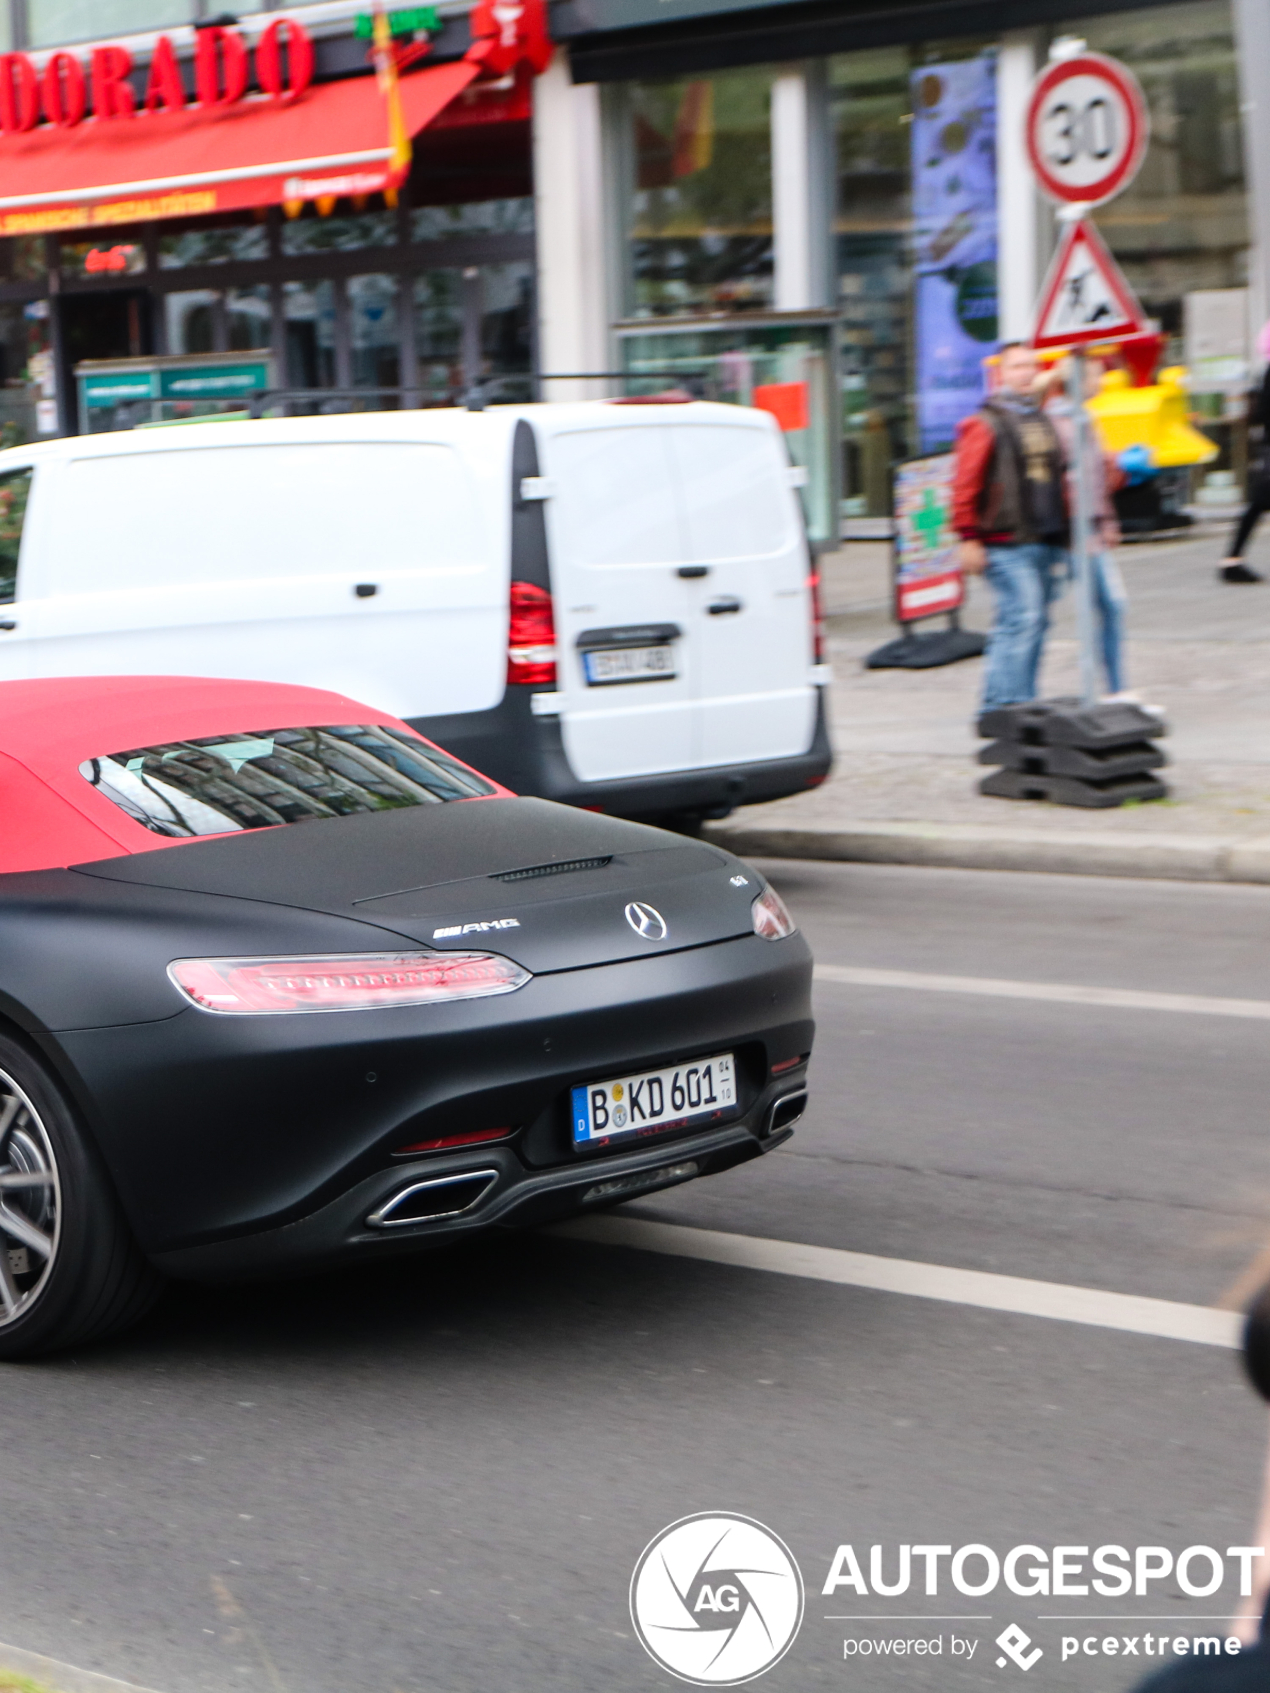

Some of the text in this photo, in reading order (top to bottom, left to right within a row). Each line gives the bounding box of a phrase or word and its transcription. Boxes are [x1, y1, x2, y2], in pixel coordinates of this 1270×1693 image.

[1046, 98, 1116, 166] 30
[462, 918, 521, 934] AMG
[718, 1060, 730, 1073] 04
[590, 1064, 718, 1131] B KD 601
[577, 1119, 586, 1132] D
